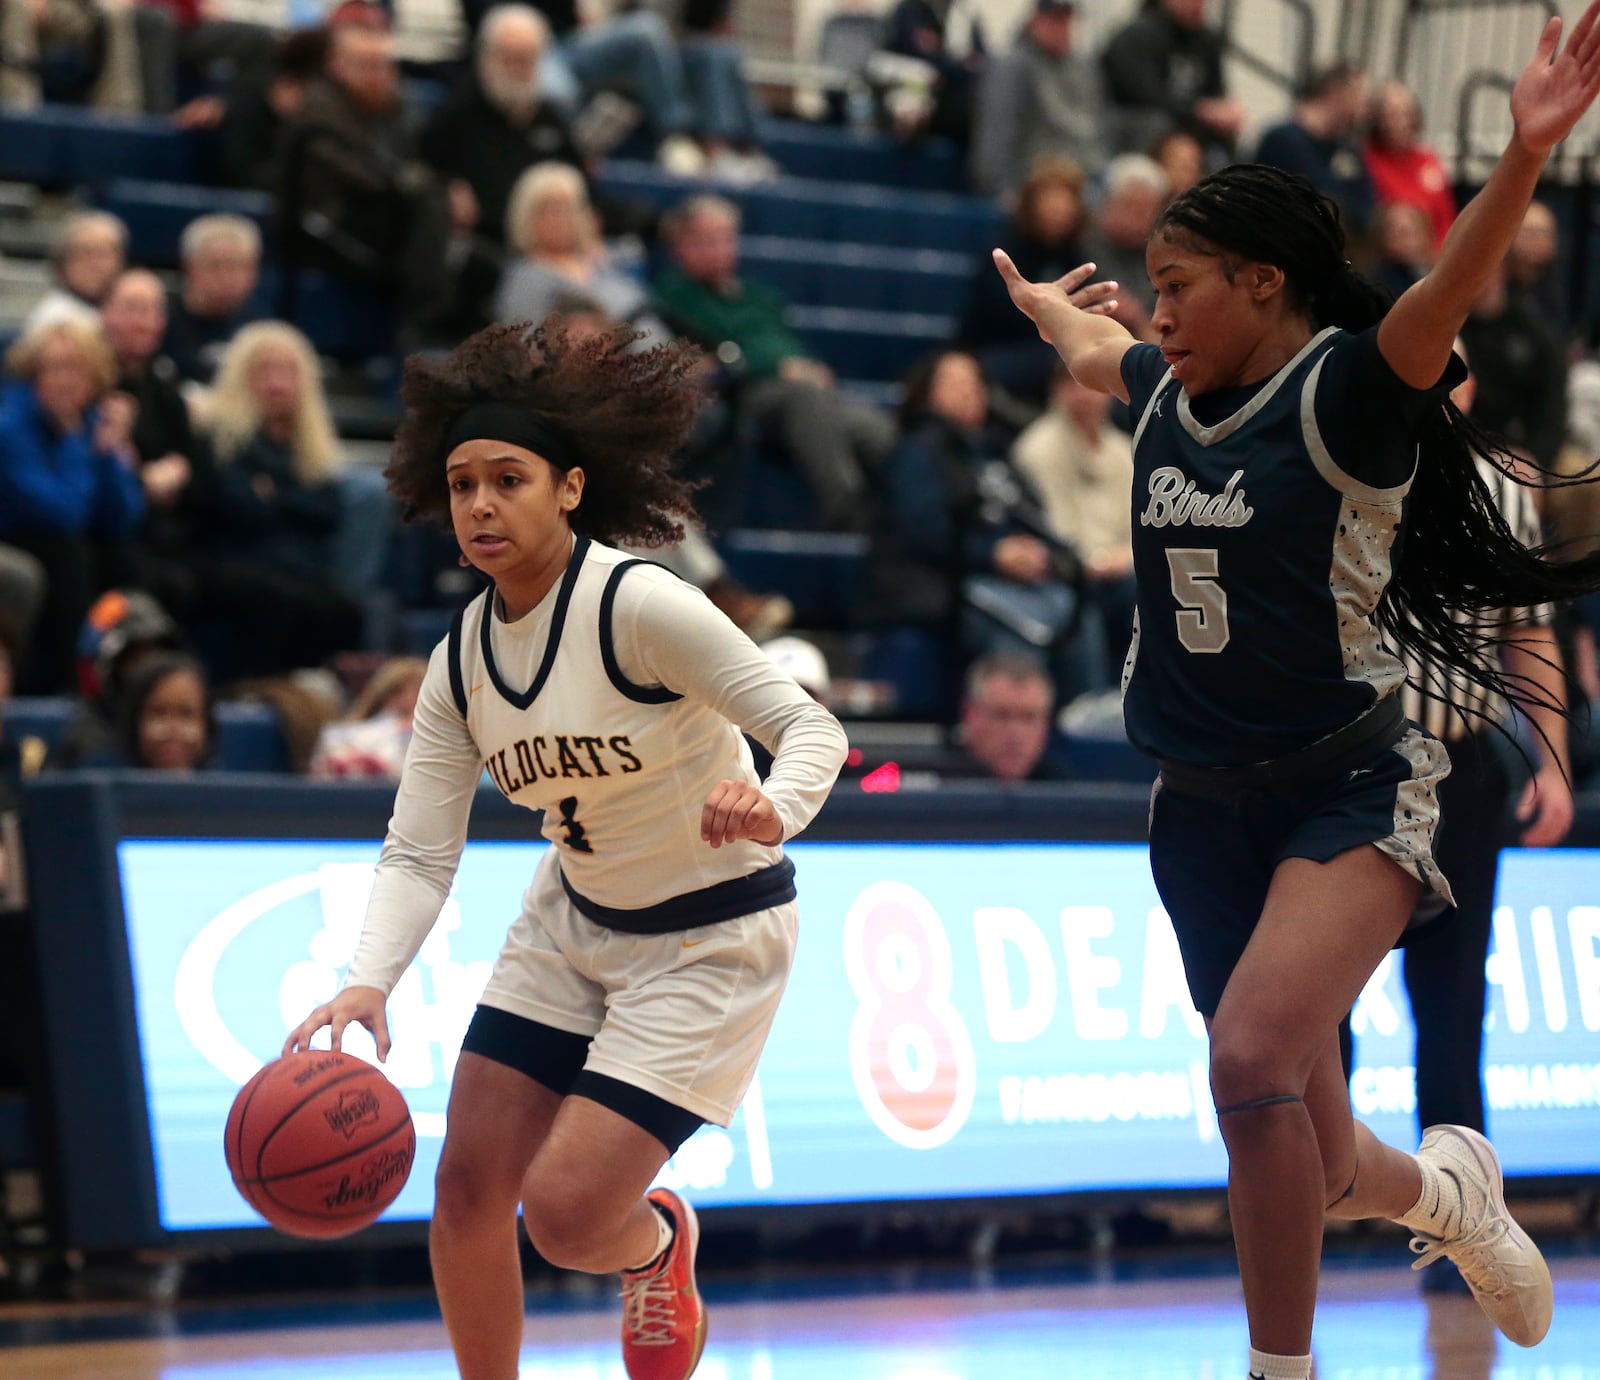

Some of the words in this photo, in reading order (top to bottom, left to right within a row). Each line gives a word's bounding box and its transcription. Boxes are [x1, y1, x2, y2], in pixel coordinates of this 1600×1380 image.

[1140, 466, 1254, 528] Birds
[1165, 548, 1230, 654] 5
[485, 735, 642, 797] ILDCATS
[843, 880, 976, 1149] 8
